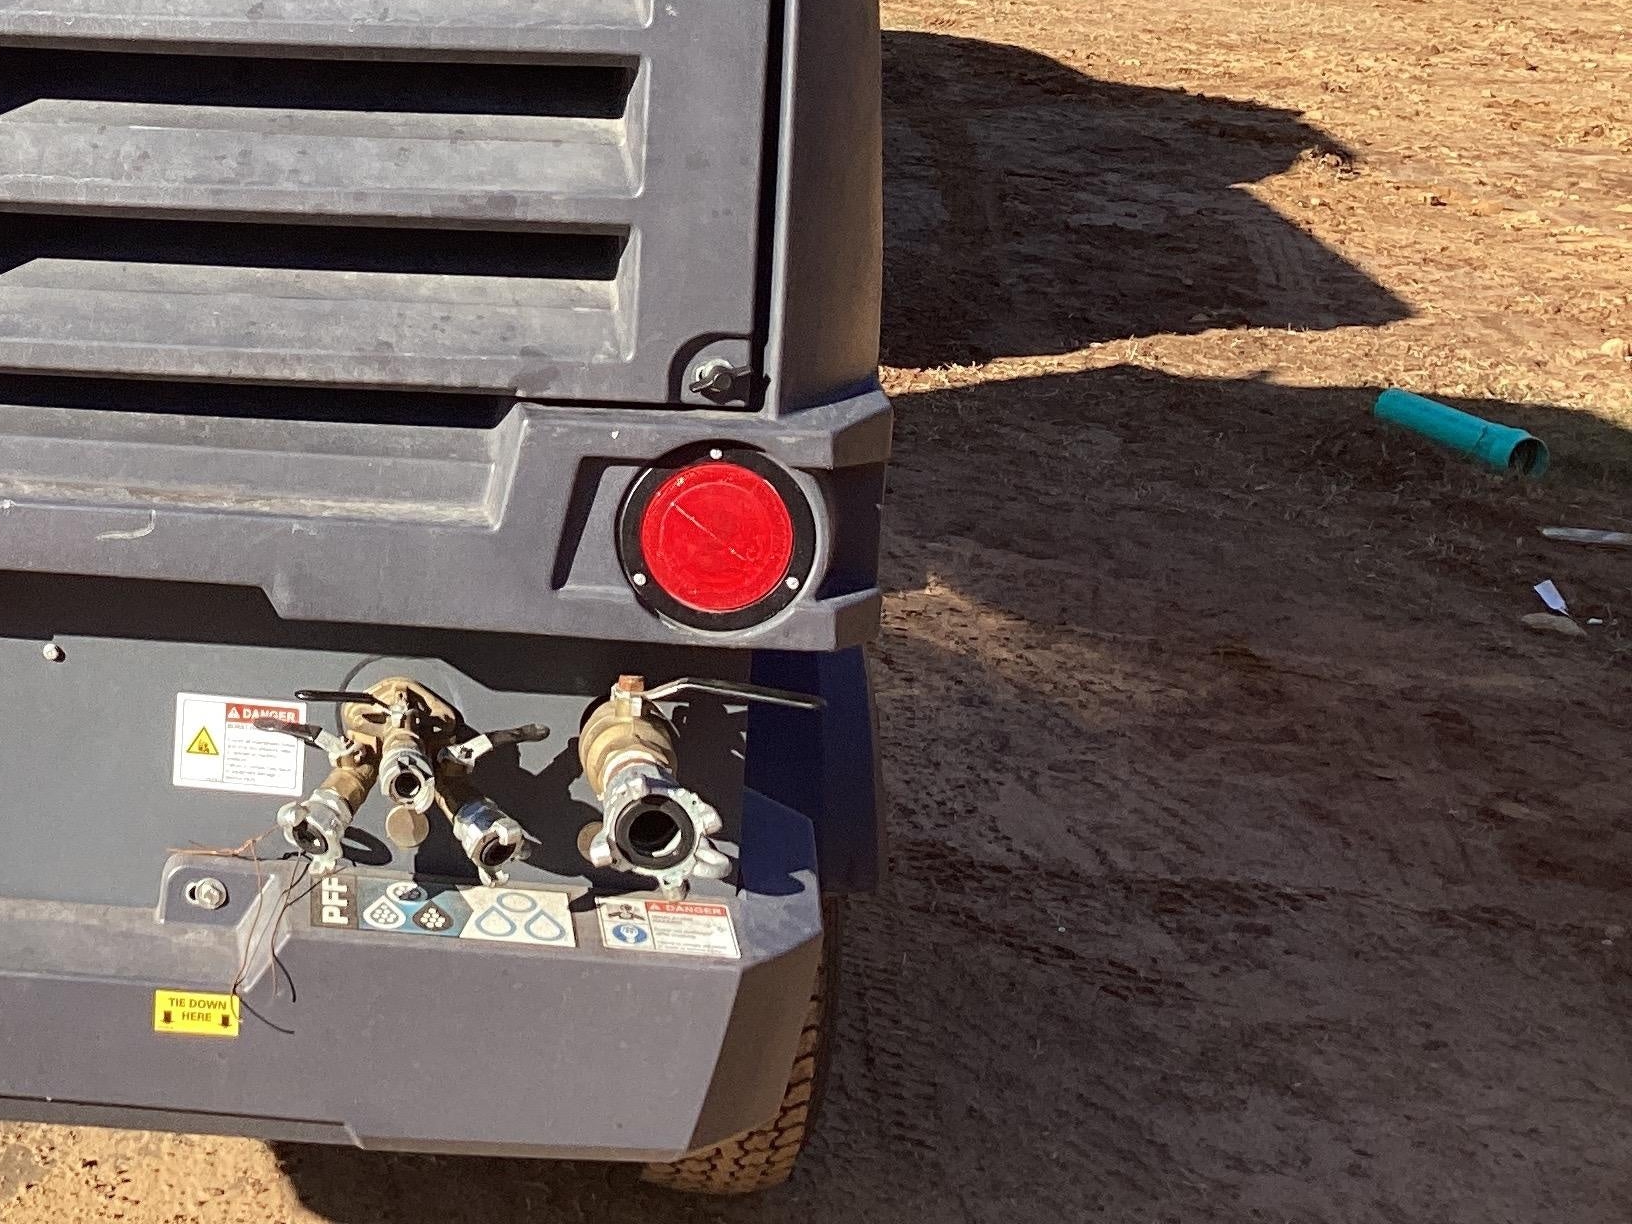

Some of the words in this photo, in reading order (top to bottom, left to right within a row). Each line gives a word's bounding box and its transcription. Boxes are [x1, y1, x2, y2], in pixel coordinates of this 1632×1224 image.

[242, 707, 297, 722] DANGER
[665, 905, 722, 916] DANGER
[168, 997, 186, 1008] TIE
[188, 999, 227, 1010] DOWN
[181, 1011, 212, 1022] HERE
